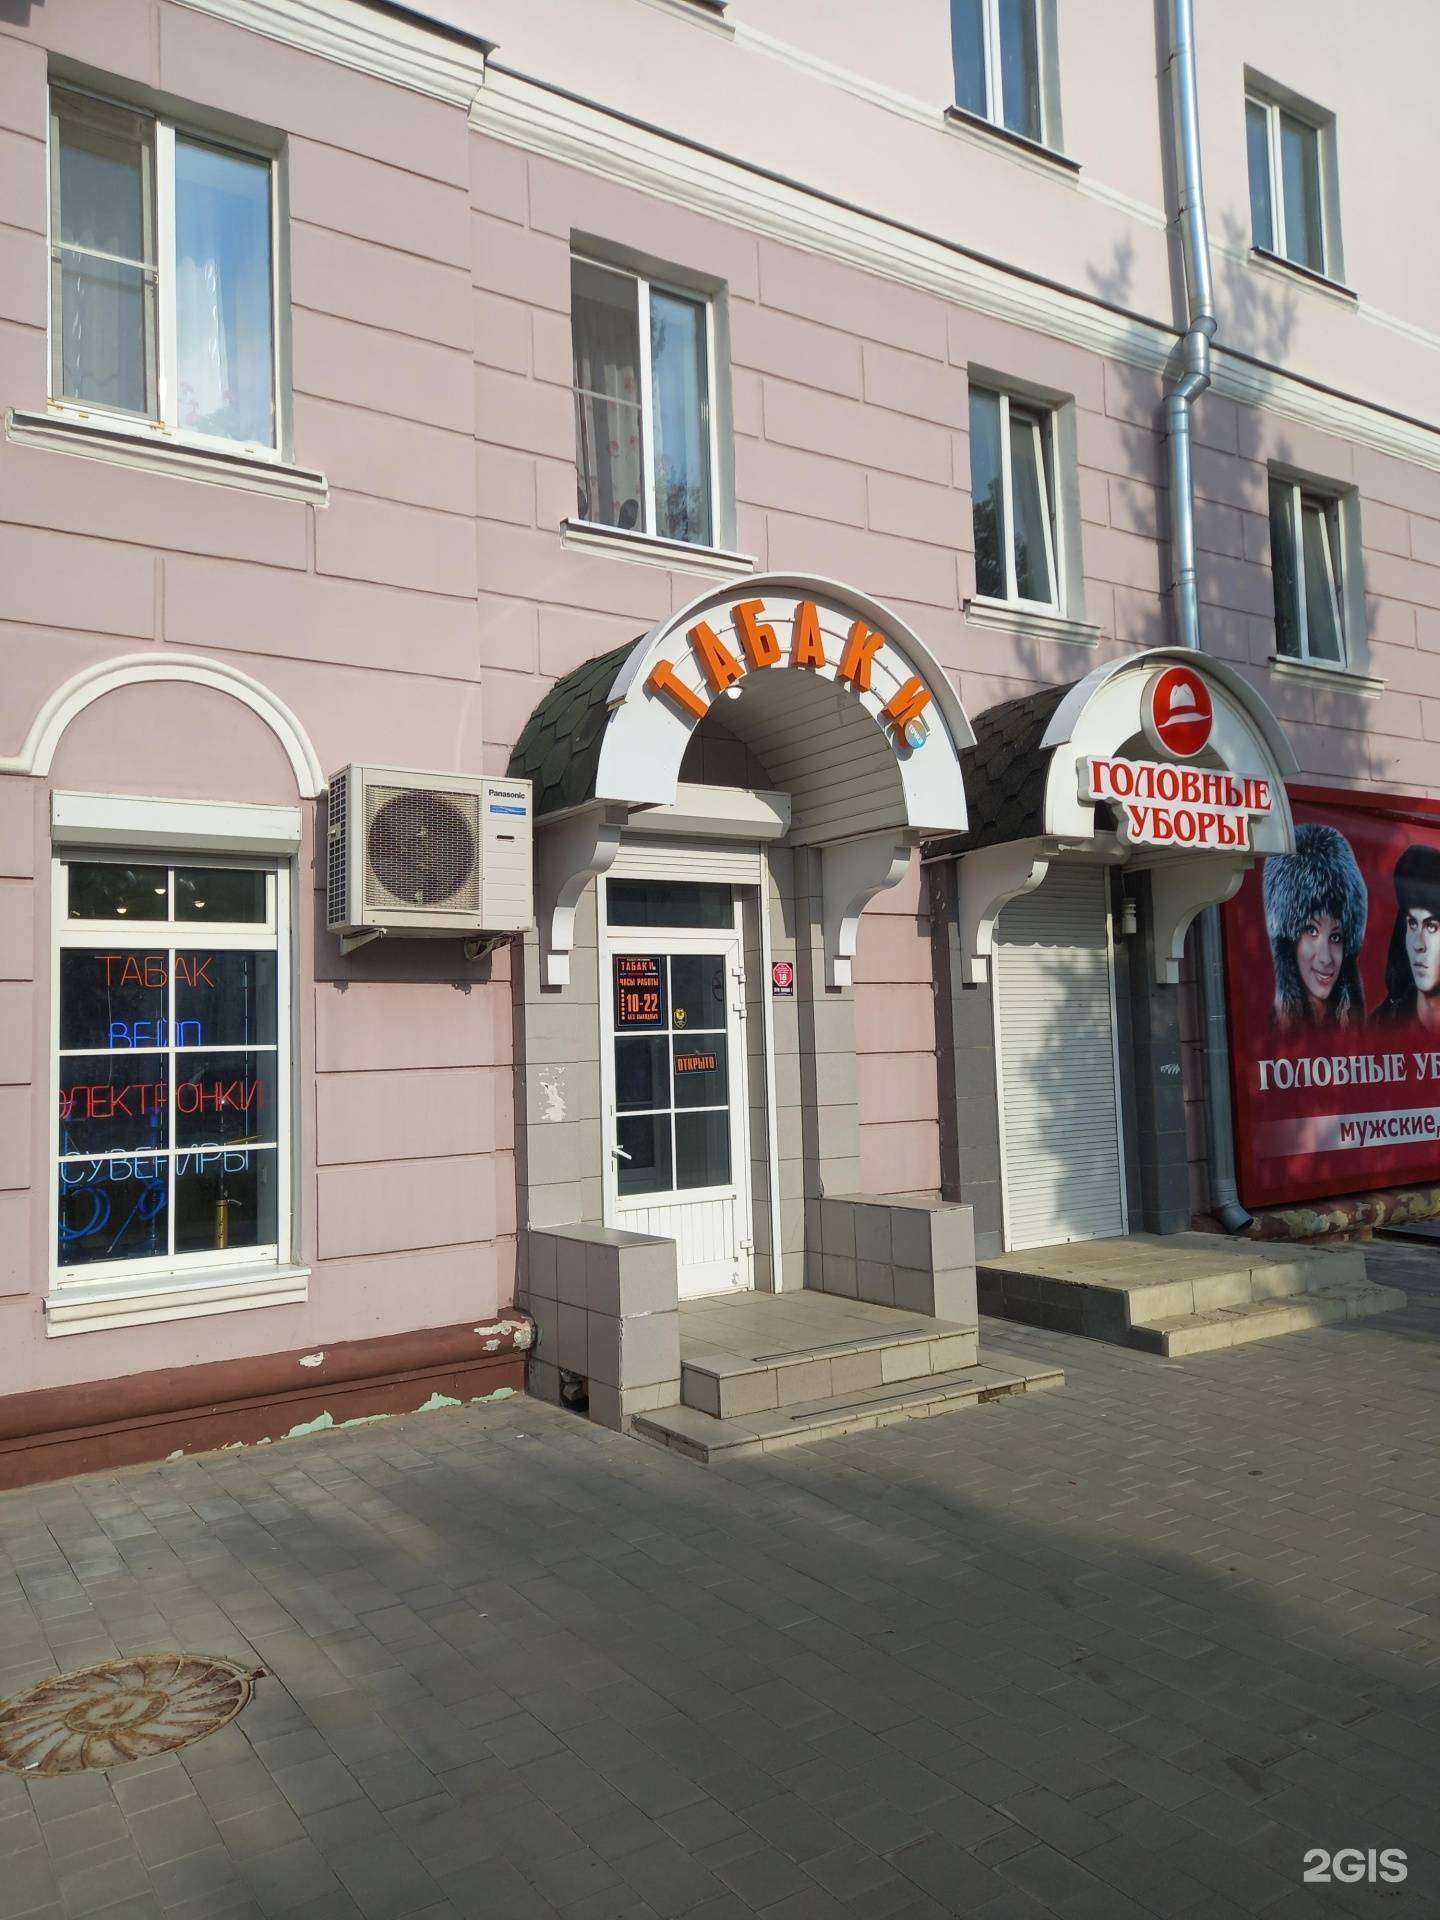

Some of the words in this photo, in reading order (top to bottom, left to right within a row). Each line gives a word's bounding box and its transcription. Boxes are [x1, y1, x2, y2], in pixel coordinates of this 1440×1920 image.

[647, 598, 932, 738] ТАБАКИ
[488, 788, 526, 800] Panasonic
[1091, 761, 1272, 810] ГОЛОВНЫЕ
[1127, 804, 1249, 846] УБОРЫ
[95, 956, 215, 989] ТАБАК
[627, 993, 658, 1012] 10-22
[109, 1018, 201, 1049] ВЕЙП
[677, 1056, 715, 1071] ОТКРЫТО
[1257, 1053, 1407, 1091] ГОЛОВНЫЕ
